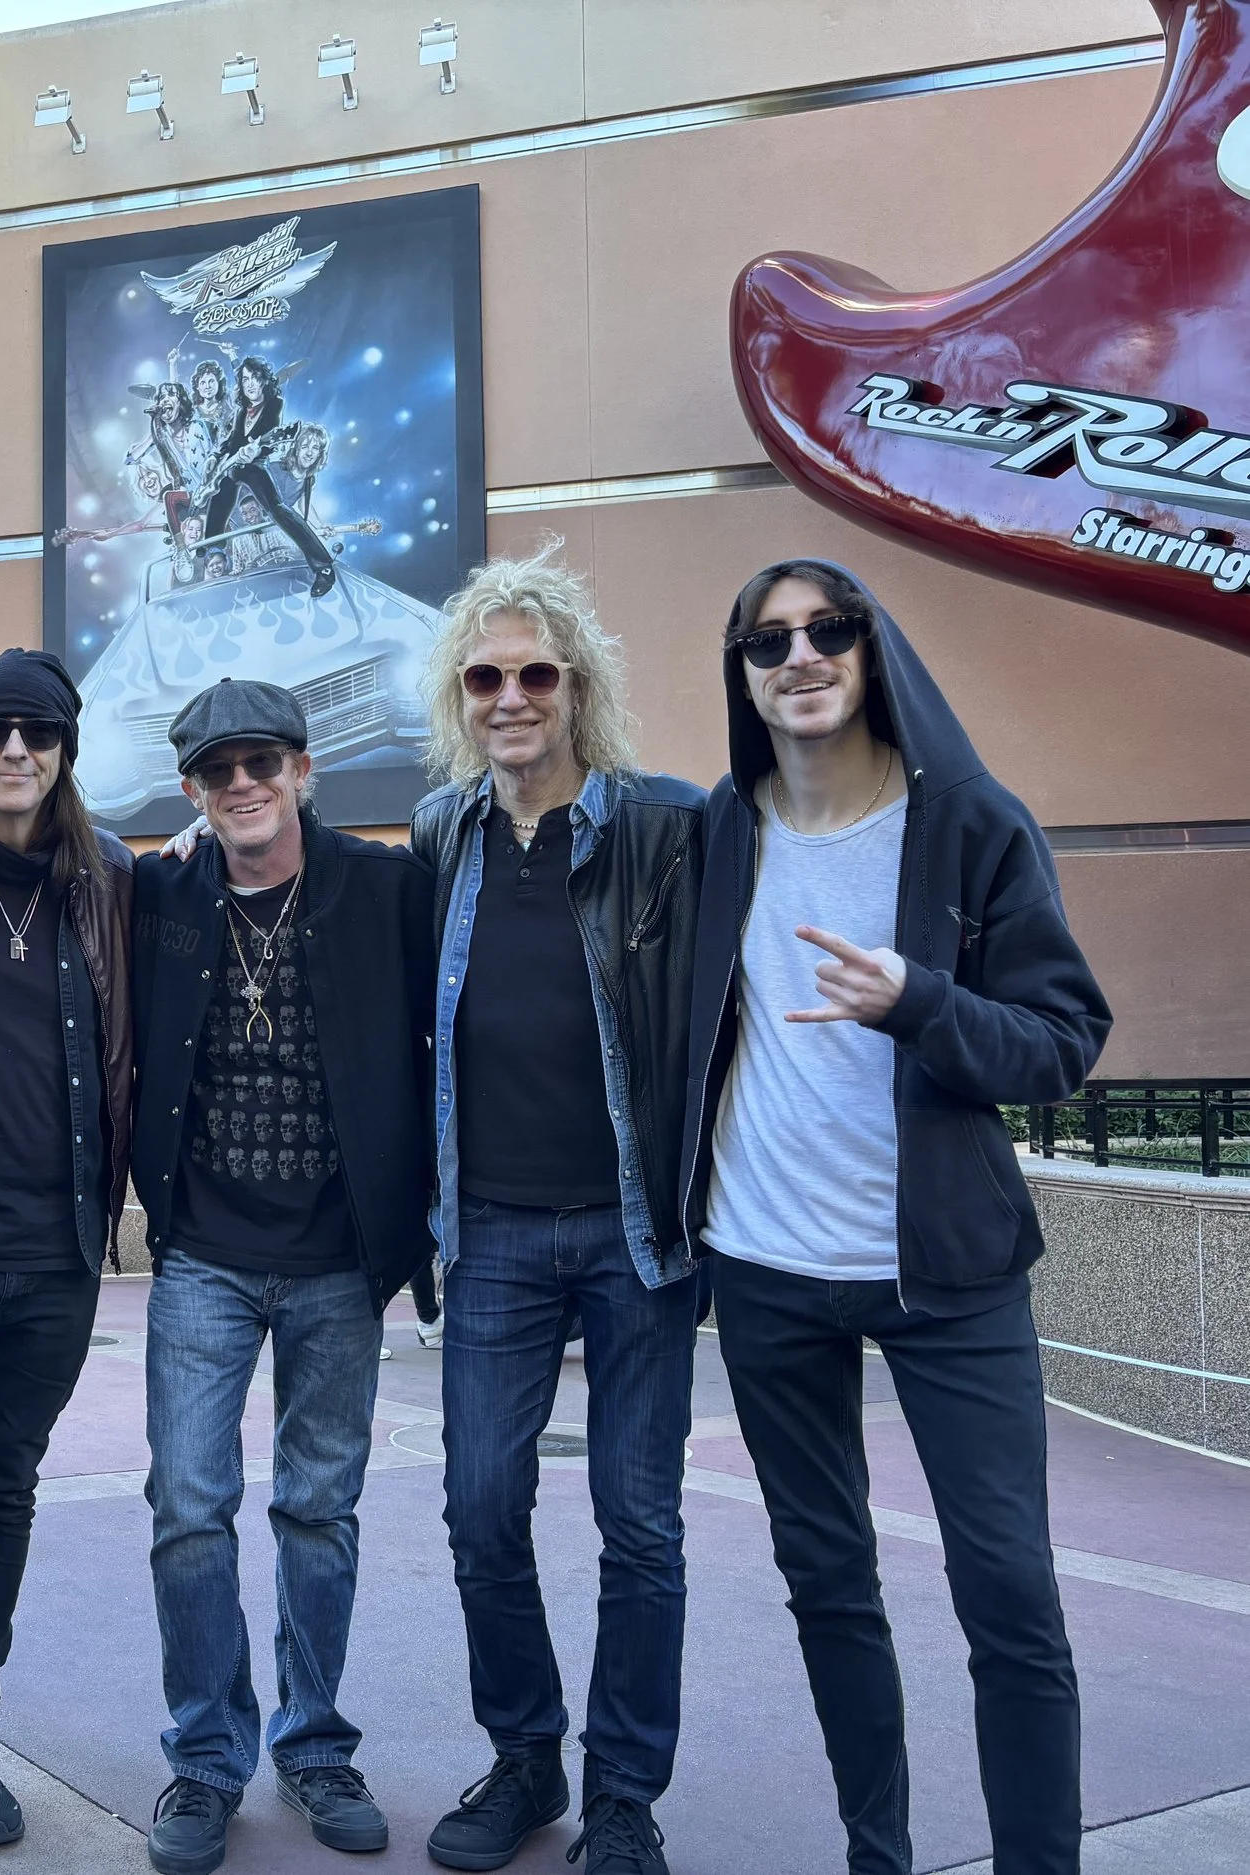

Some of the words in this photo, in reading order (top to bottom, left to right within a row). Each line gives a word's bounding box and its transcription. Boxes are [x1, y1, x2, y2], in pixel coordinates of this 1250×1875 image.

[178, 237, 297, 309] Roller
[224, 248, 303, 299] Coaster
[1074, 510, 1250, 591] Starring
